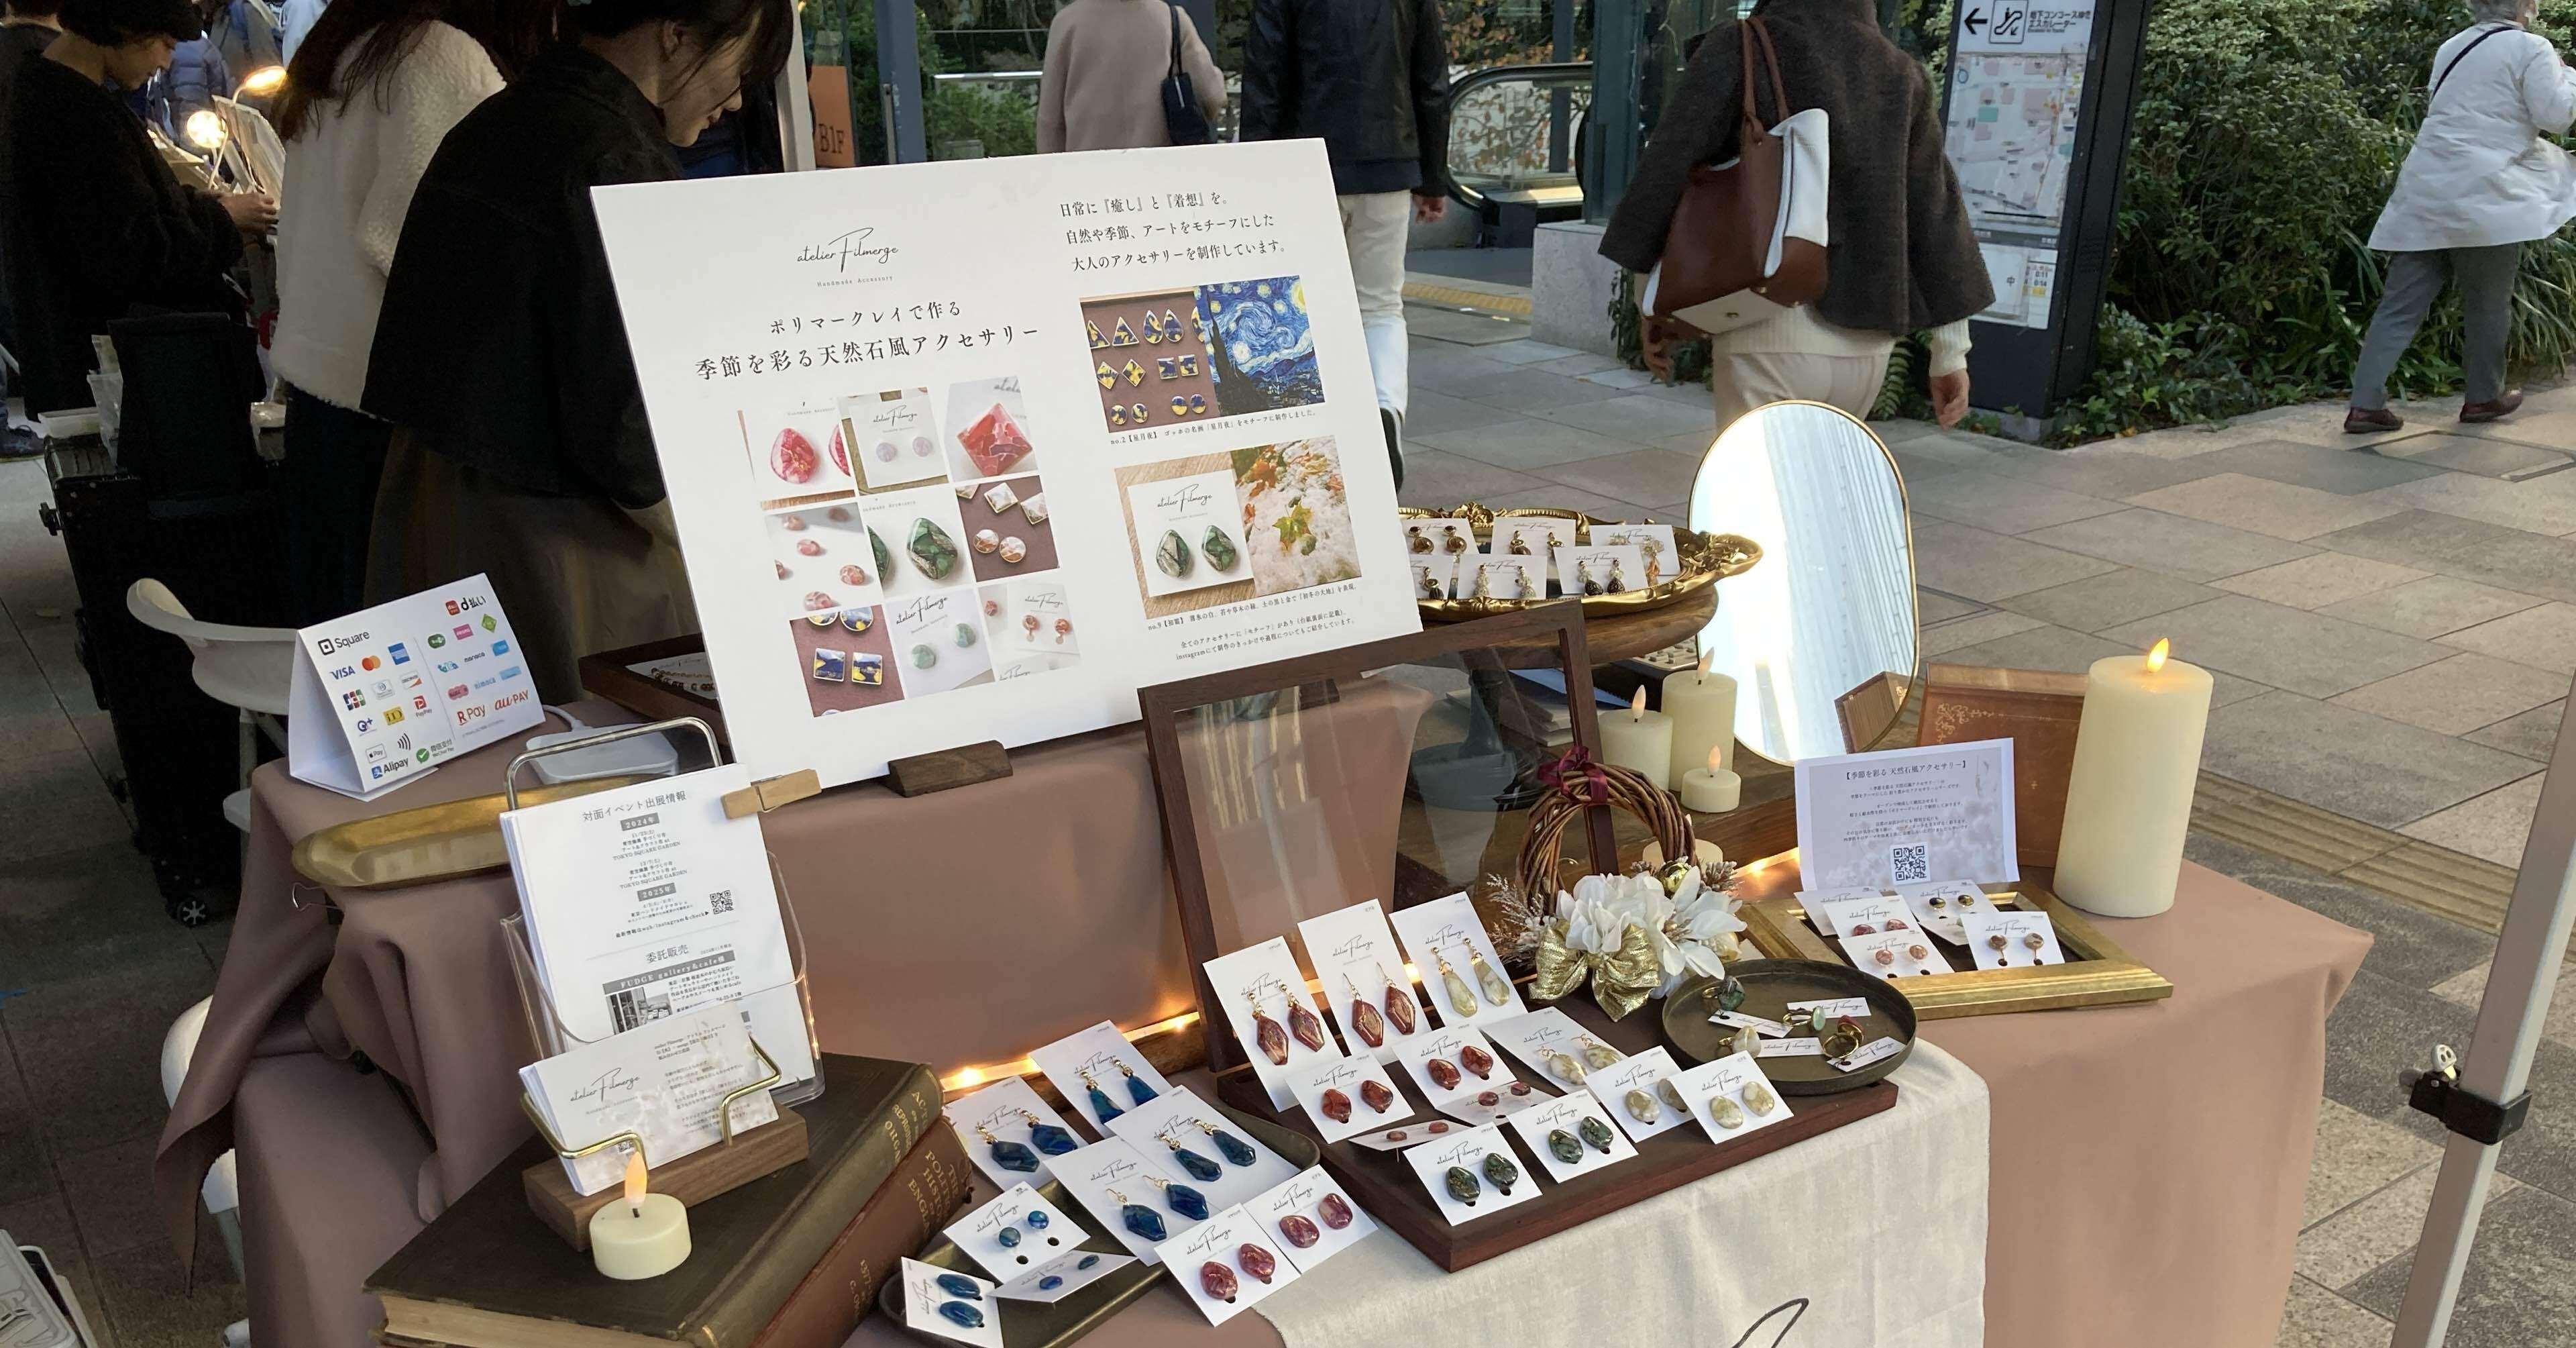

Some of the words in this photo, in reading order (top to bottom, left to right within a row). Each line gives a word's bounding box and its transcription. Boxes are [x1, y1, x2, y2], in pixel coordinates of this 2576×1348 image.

[1060, 191, 1228, 218] 日常に『癒し』と『着想』を。
[1067, 213, 1275, 245] 自然や季節、アートをモチーフにした
[797, 244, 836, 262] atelier
[828, 227, 899, 273] Filmerge
[1072, 239, 1286, 272] 大人のアクセサリーを制作しています。
[769, 301, 961, 335] ポリマークレイで作る
[694, 325, 1038, 380] 季節を彩る天然石風アクセサリー
[461, 595, 486, 611] d払い
[334, 631, 370, 649] Square
[330, 666, 356, 680] VISA
[513, 690, 529, 704] PAY
[466, 705, 485, 720] Pay
[383, 758, 409, 774] Alipay
[582, 790, 687, 822] 対面イベント出展情報
[625, 816, 655, 829] 2024年
[646, 944, 689, 964] 委託販売
[620, 974, 655, 989] FUDGE
